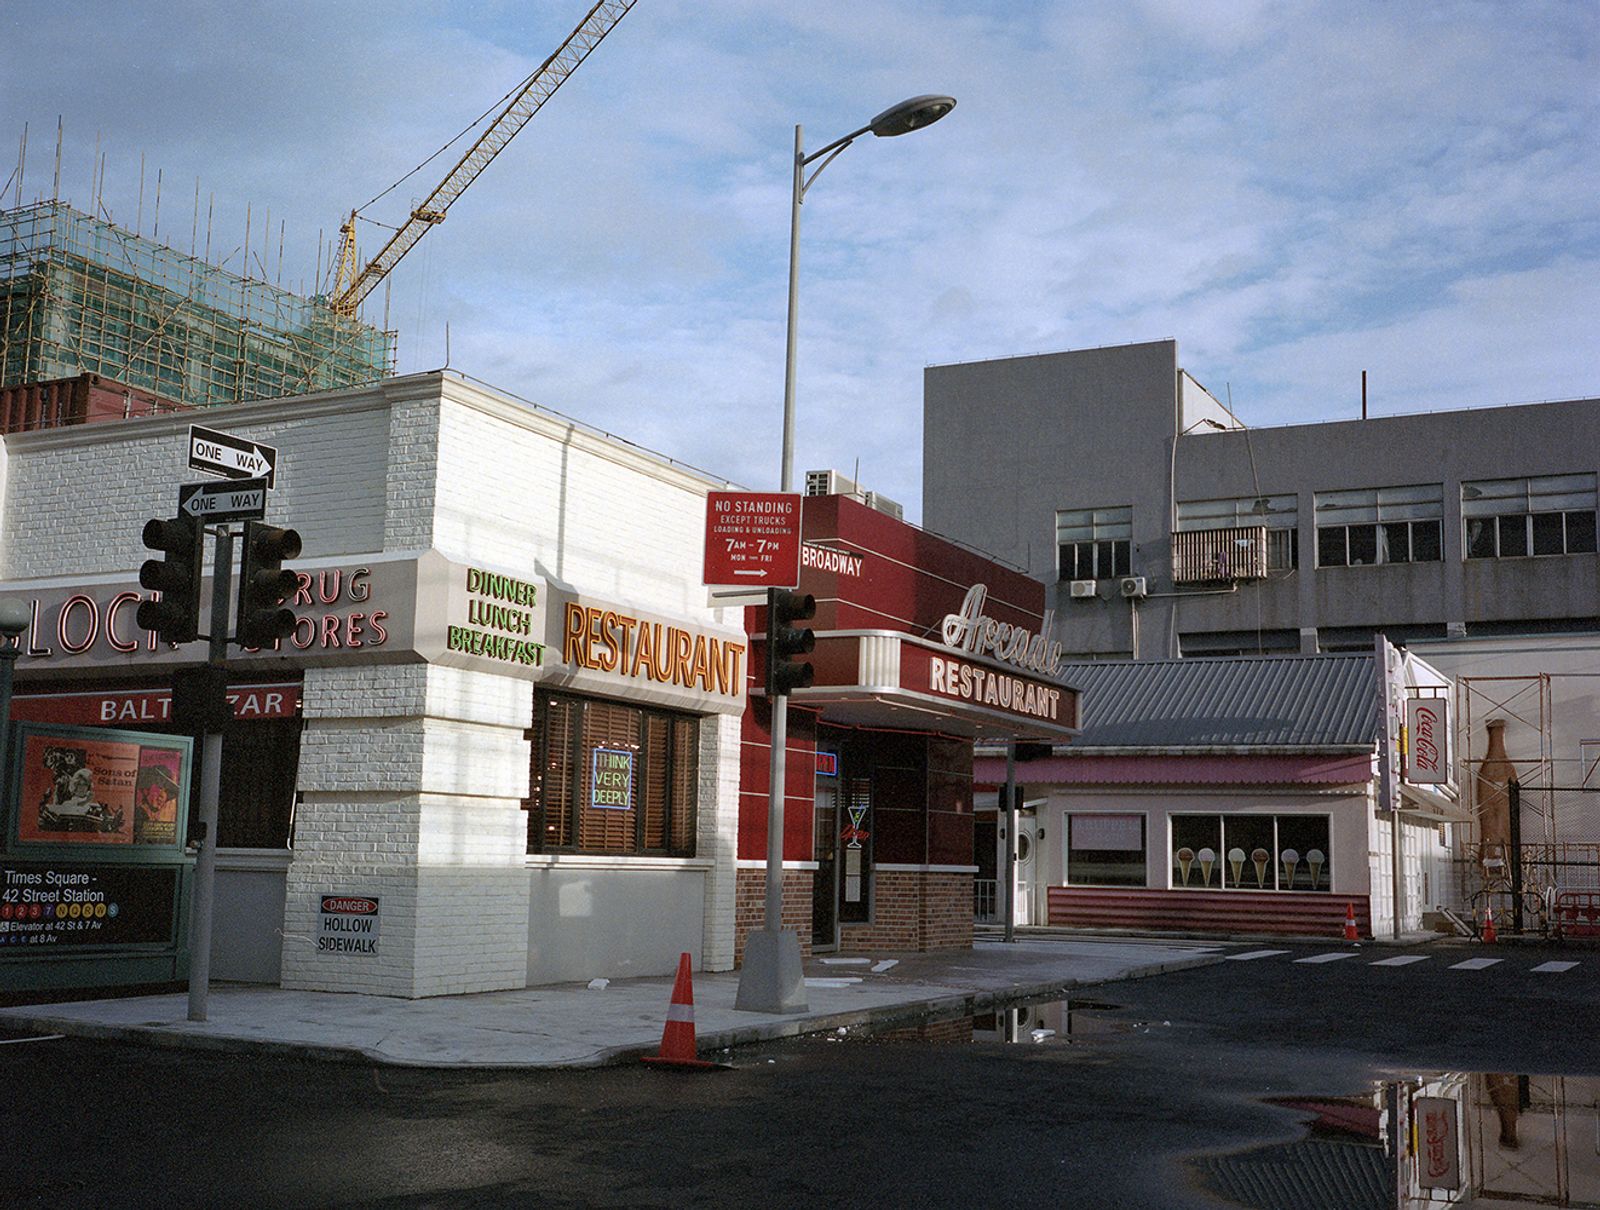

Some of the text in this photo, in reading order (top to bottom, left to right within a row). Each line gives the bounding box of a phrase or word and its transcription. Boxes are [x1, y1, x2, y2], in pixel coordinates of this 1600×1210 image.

[196, 442, 222, 461] ONE
[236, 453, 263, 472] WAY
[191, 493, 259, 511] ONE WAY
[715, 500, 792, 514] NO STANDING
[720, 515, 786, 525] EXCEPT TRUCKS
[752, 527, 792, 535] UNLOADING
[761, 554, 772, 562] FRI
[802, 546, 862, 577] BROADWAY
[278, 567, 373, 607] RUG
[466, 567, 537, 608] DINNER
[10, 591, 180, 657] LOC
[468, 599, 532, 636] LUNCH
[244, 615, 388, 652] ORES
[446, 625, 546, 667] BREAKFAST
[564, 601, 745, 697] RESTAURANT
[931, 656, 1060, 720] RESTAURANT
[1415, 706, 1439, 774] Coca-Cola
[597, 752, 631, 769] THINK
[93, 767, 137, 777] Sons of
[595, 772, 630, 787] VERY
[97, 777, 132, 786] Satan
[593, 789, 629, 806] DEEPLY
[5, 870, 42, 884] Times
[45, 871, 89, 887] Square
[2, 888, 104, 902] 42 Street Station
[330, 901, 369, 911] DANGER
[10, 921, 44, 931] Elevator
[45, 922, 53, 930] at
[54, 921, 65, 931] 42
[67, 921, 75, 930] St
[86, 921, 90, 930] 7
[92, 920, 102, 929] Av
[324, 917, 373, 933] HOLLOW
[46, 934, 58, 943] Av
[319, 936, 377, 953] SIDEWALK
